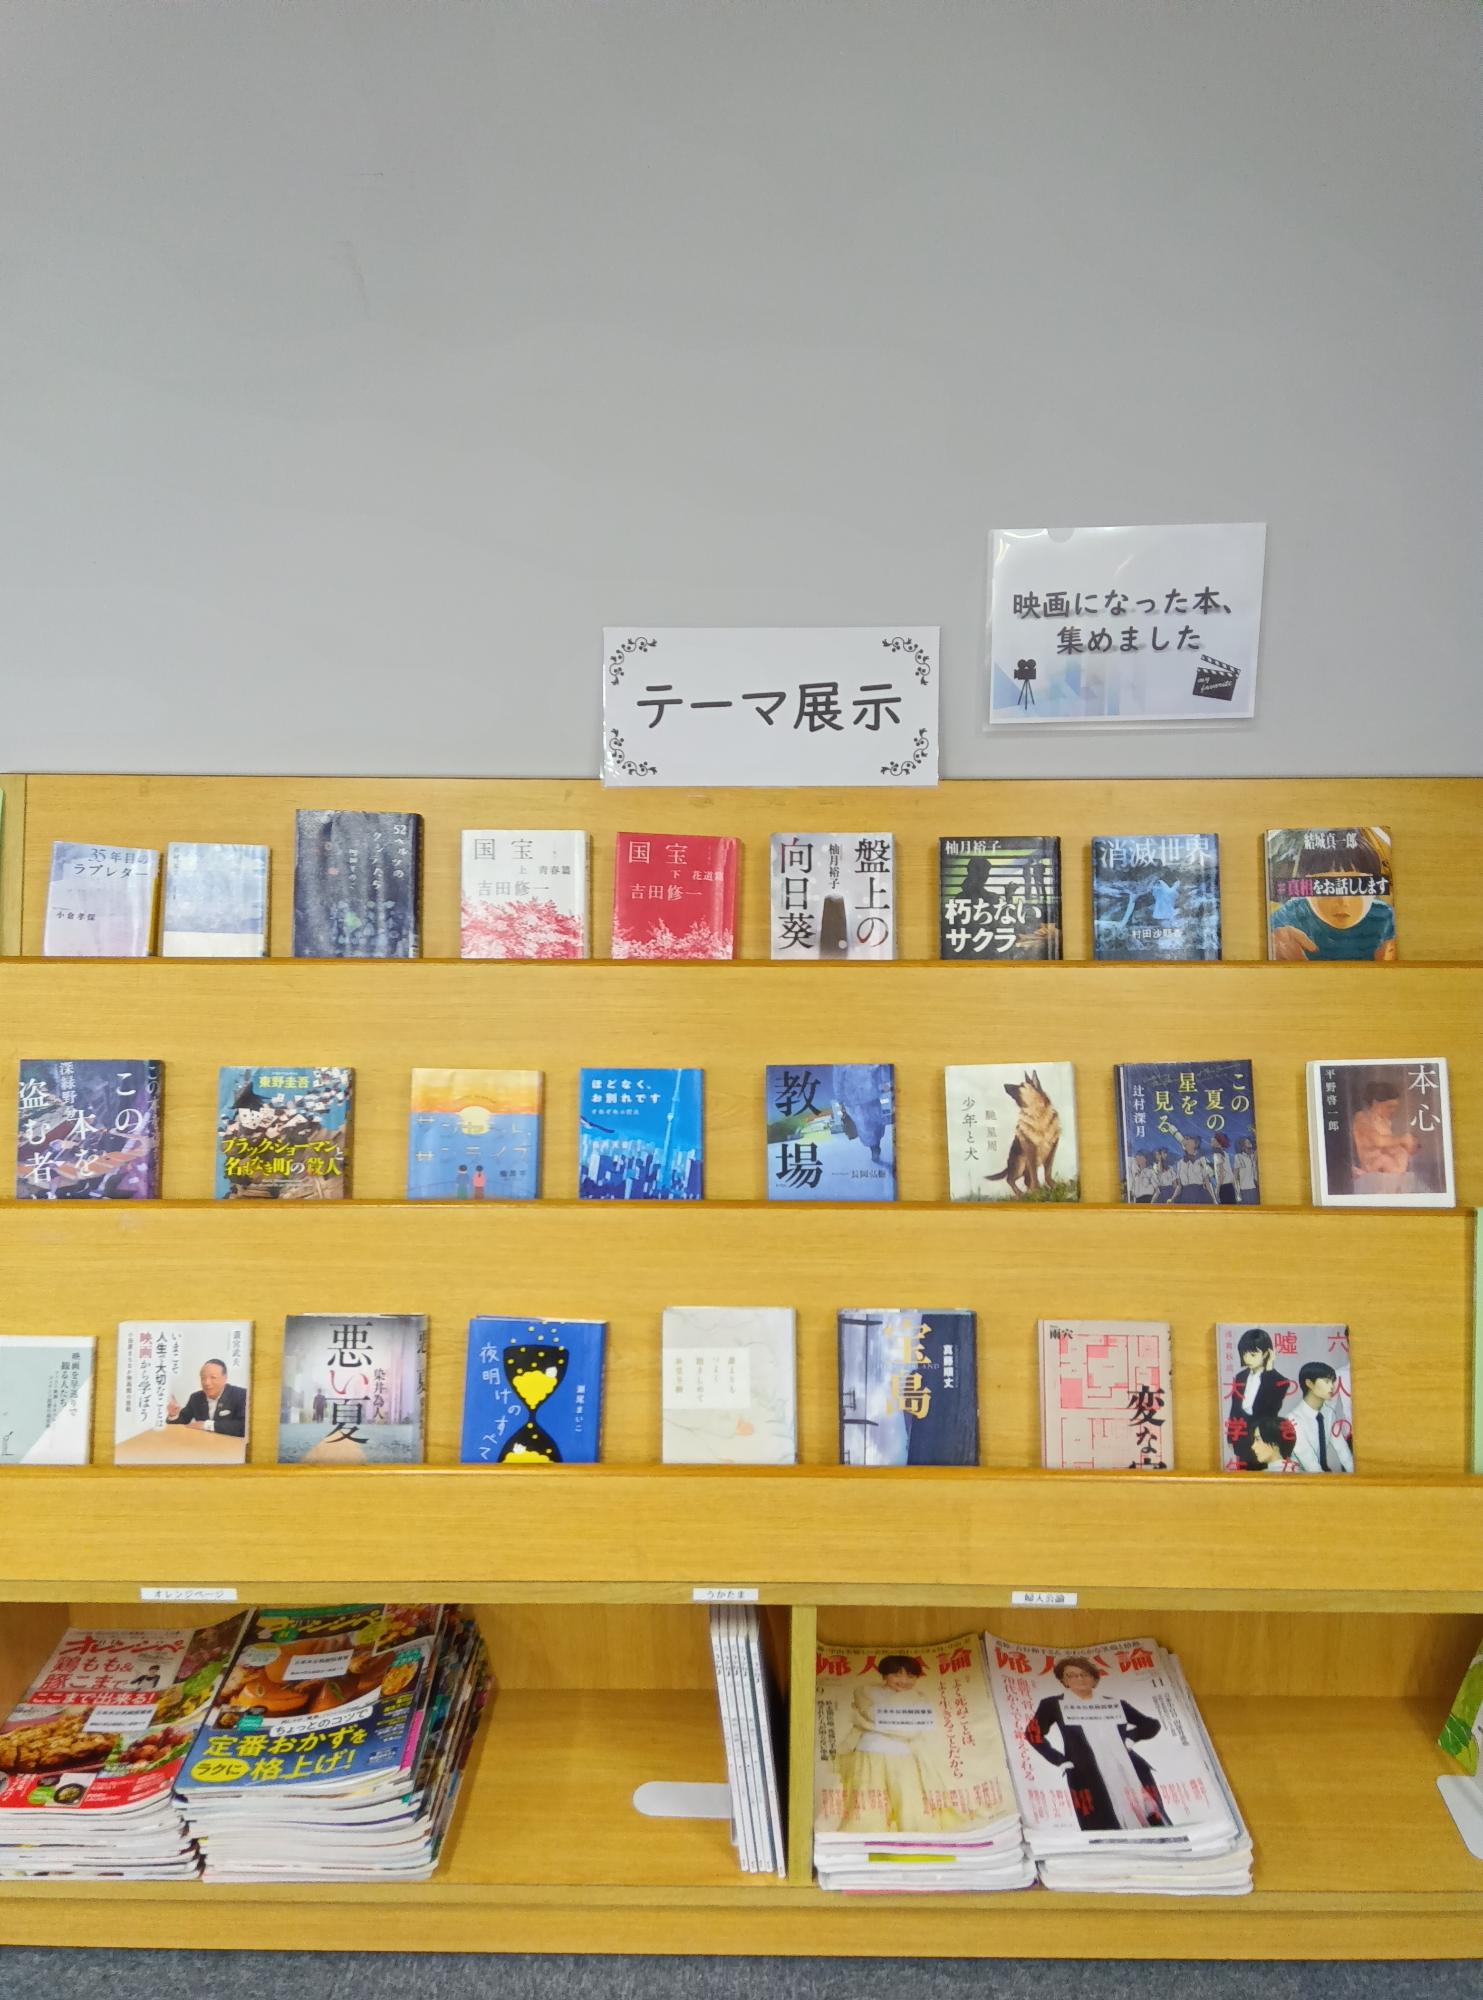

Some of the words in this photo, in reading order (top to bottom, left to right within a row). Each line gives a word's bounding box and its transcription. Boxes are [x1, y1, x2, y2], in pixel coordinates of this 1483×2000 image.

[1013, 586, 1232, 619] 映画になった本、
[1056, 625, 1201, 655] 集めました
[636, 681, 902, 733] テーマ展示
[474, 838, 534, 861] 国宝
[628, 840, 689, 865] 国宝
[945, 839, 1002, 856] 柚月裕子
[1100, 837, 1212, 868] 消滅世界
[1303, 831, 1359, 851] 結城真一郎
[73, 863, 150, 879] ラブレター
[671, 869, 681, 880] 下
[828, 843, 840, 890] 柚月裕子
[479, 880, 550, 897] 吉田修一
[630, 883, 703, 901] 吉田修一
[778, 836, 817, 950] 向日葵
[854, 837, 891, 948] 盤上の
[944, 897, 1042, 926] 朽ちない
[945, 927, 1017, 953] サクラ
[259, 1076, 309, 1089] 東野圭吾
[591, 1093, 662, 1104] お別れです
[592, 1079, 652, 1090] ほどなく、
[1178, 1072, 1199, 1116] 星を
[1231, 1072, 1250, 1113] この
[1325, 1068, 1340, 1132] 平野啓一郎
[1407, 1064, 1441, 1132] 本心
[115, 1072, 143, 1135] この
[1132, 1084, 1147, 1138] 辻村深月
[1153, 1090, 1175, 1134] 見る
[1204, 1088, 1225, 1132] 夏の
[18, 1078, 65, 1199] 盗む者
[65, 1109, 100, 1177] 本を
[774, 1070, 824, 1189] 教場
[961, 1096, 980, 1162] 少年と犬
[225, 1156, 341, 1177] 名もなき町の殺人
[1049, 1327, 1074, 1340] 雨穴
[139, 1332, 152, 1422] 映画から学ぼう
[325, 1321, 374, 1445] 悪い夏
[884, 1318, 933, 1420] 宝島
[1328, 1331, 1353, 1442] 六人の
[478, 1341, 522, 1461] 夜明けのすべて
[203, 1723, 368, 1758] 定番おかずを
[197, 1762, 242, 1776] ラクに
